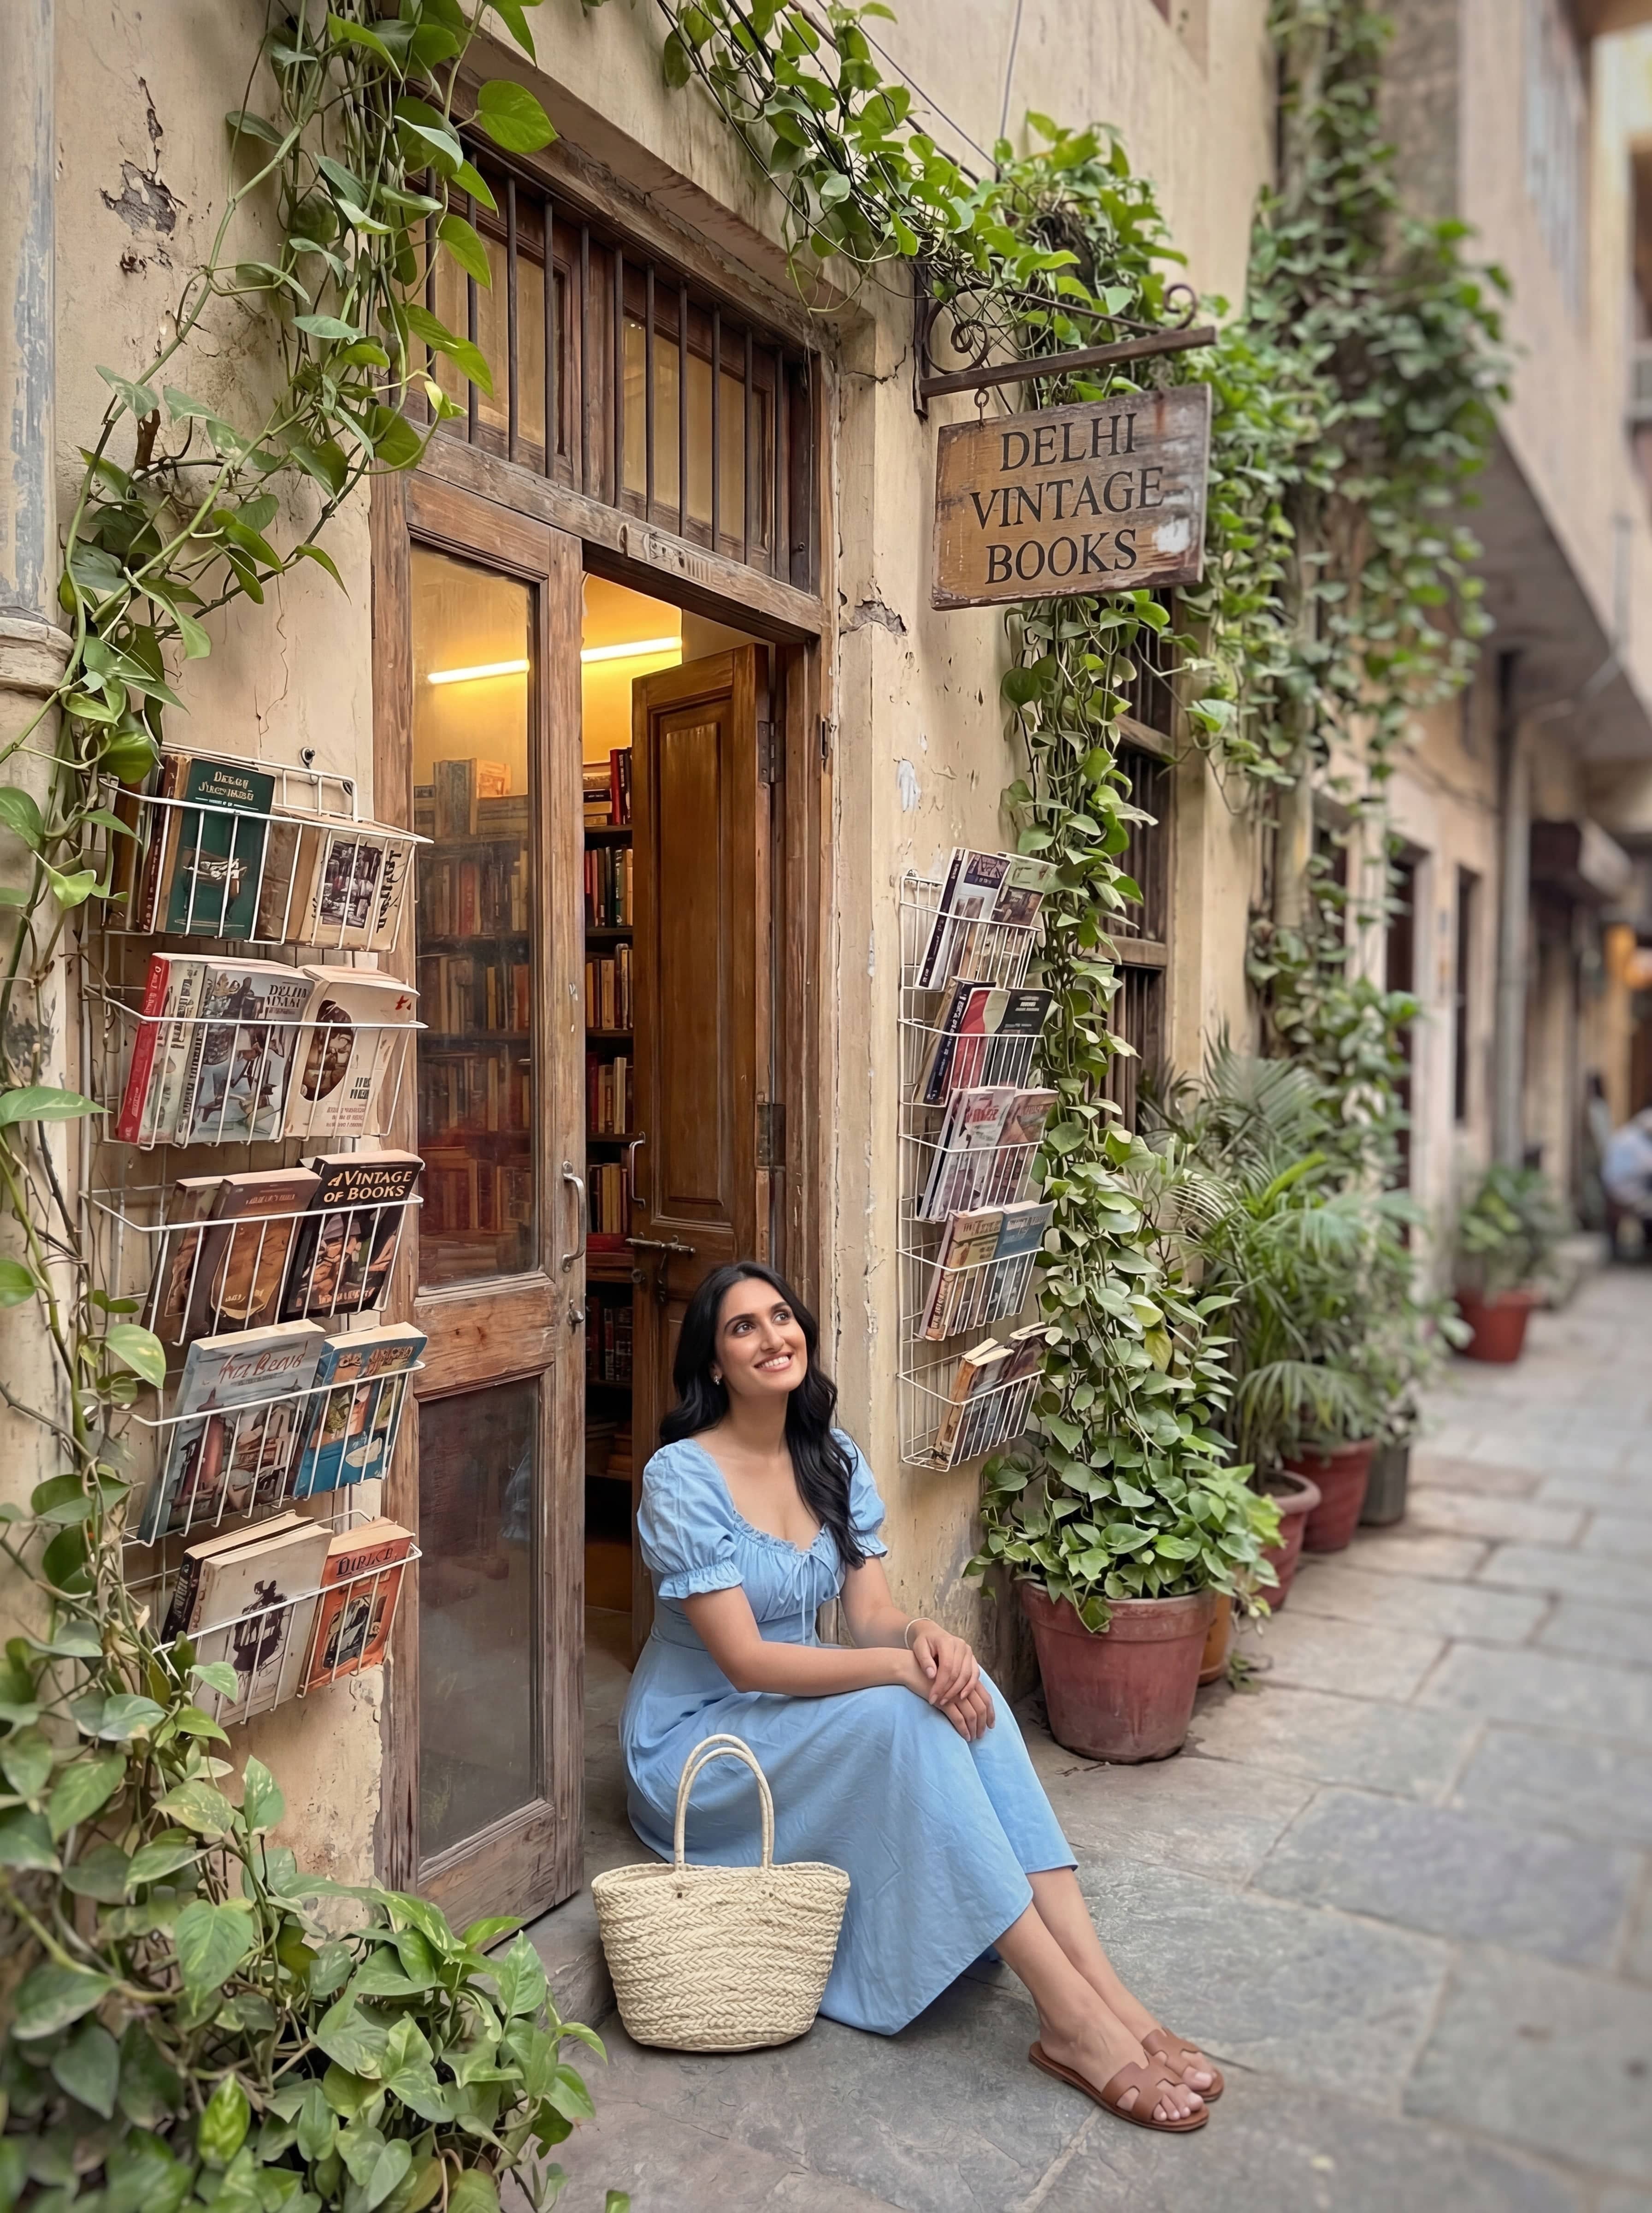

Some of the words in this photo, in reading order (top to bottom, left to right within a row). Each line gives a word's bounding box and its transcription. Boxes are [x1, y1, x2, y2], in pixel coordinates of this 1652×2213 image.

[999, 413, 1137, 472] DELHI
[969, 466, 1165, 530] VINTAGE
[984, 528, 1137, 585] BOOKS
[324, 1191, 344, 1203] OF
[346, 1185, 406, 1201] BOOKS
[327, 1172, 343, 1187] A
[345, 1170, 413, 1186] VINTAGE
